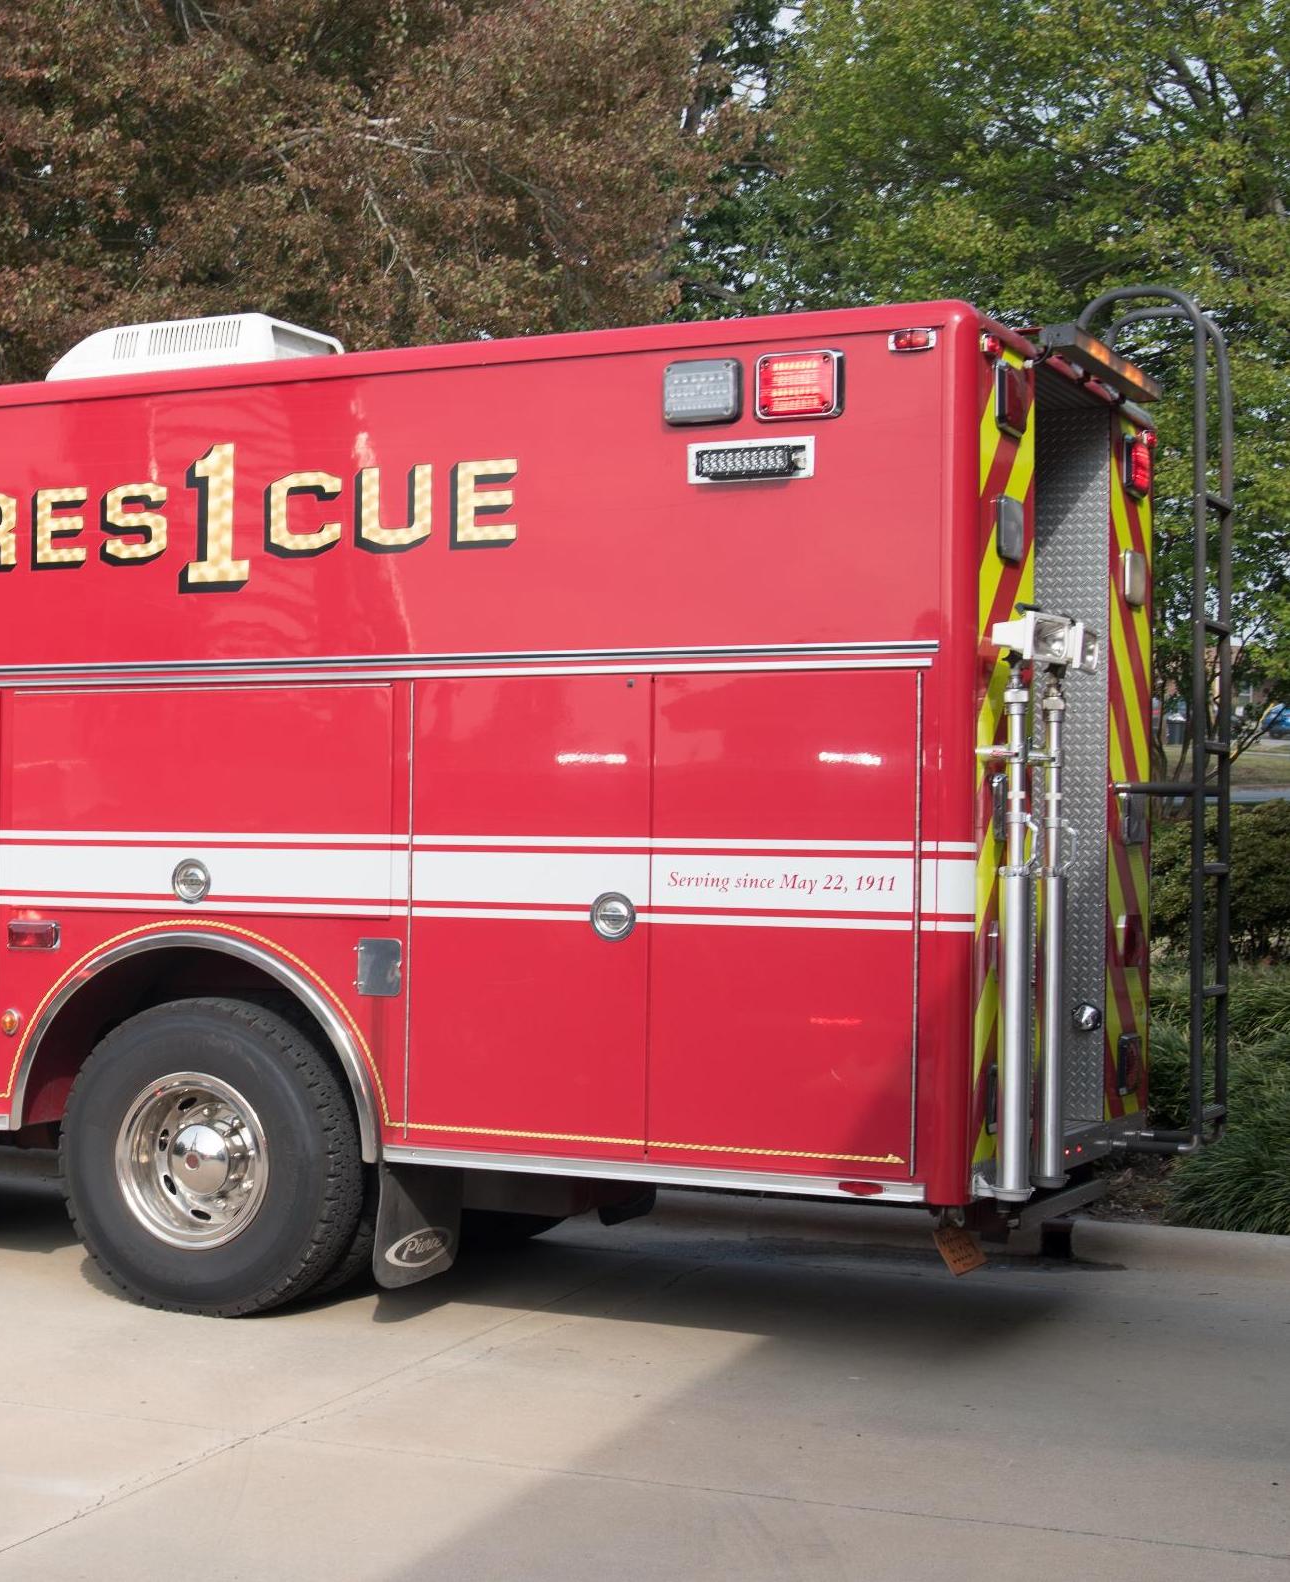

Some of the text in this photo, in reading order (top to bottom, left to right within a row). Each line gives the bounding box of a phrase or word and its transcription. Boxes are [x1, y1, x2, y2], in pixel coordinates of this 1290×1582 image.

[667, 871, 896, 894] Serving since May 22, 1911
